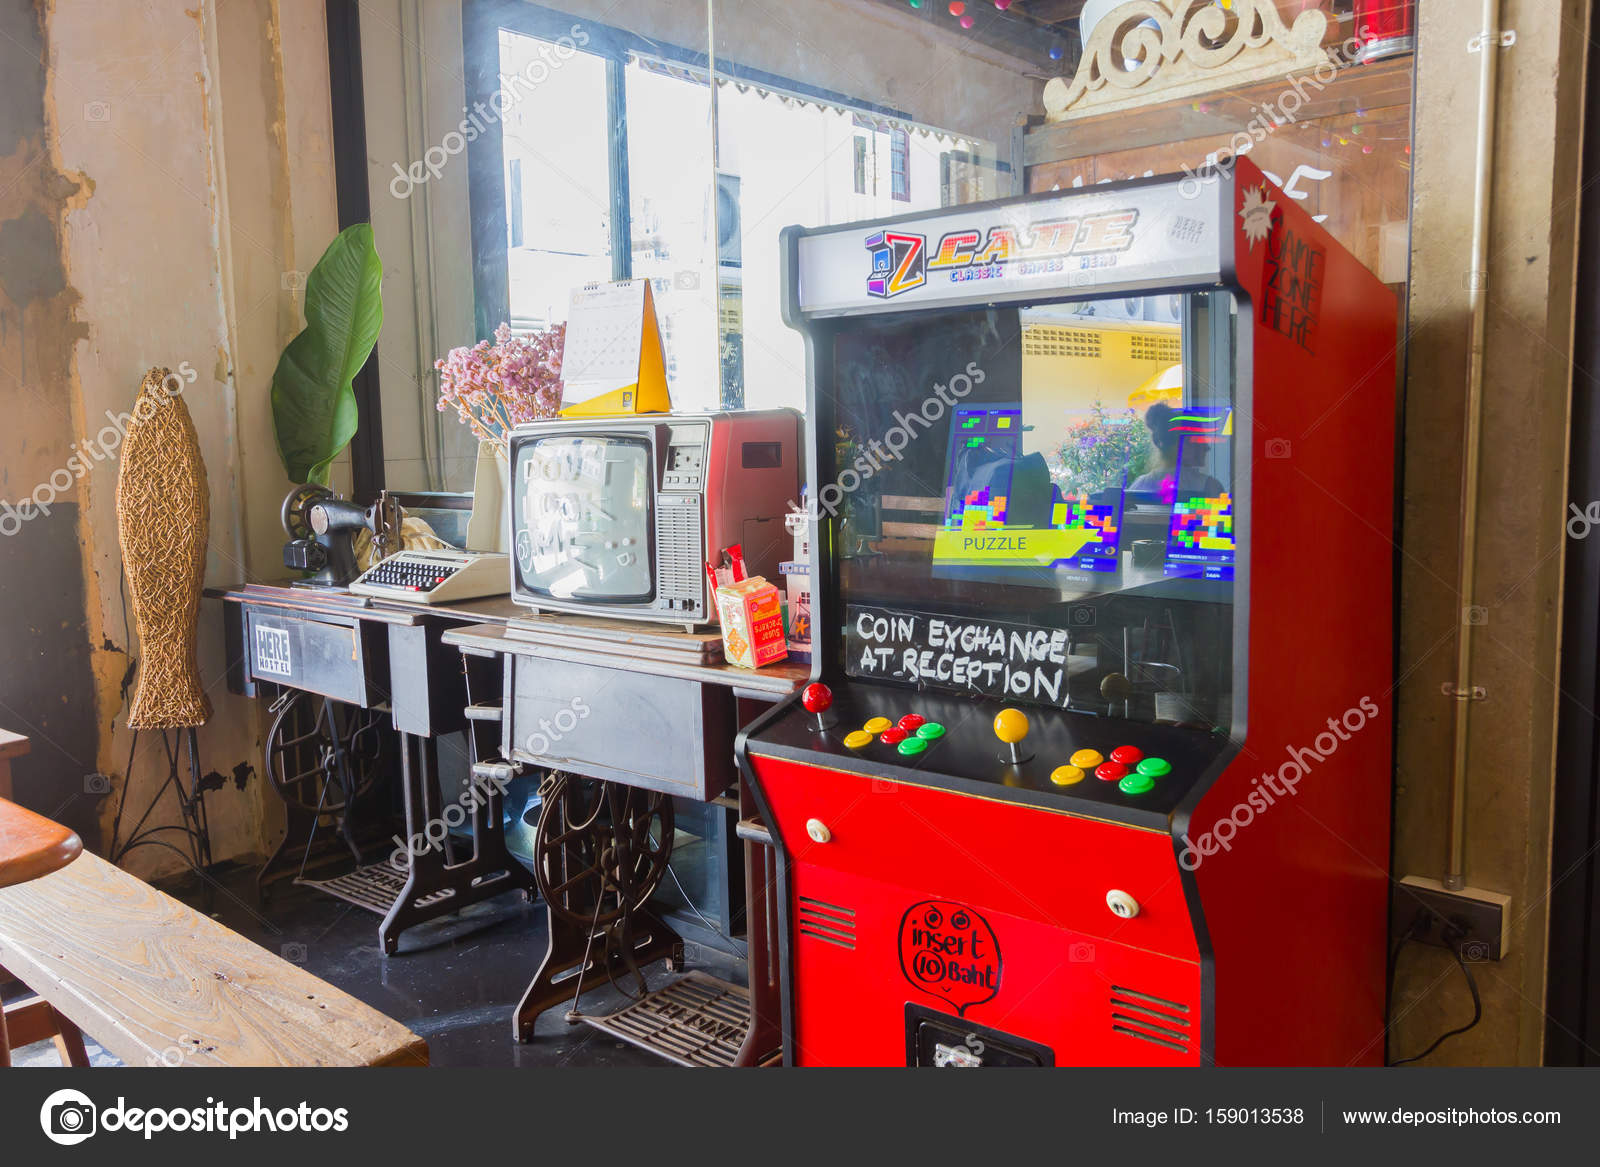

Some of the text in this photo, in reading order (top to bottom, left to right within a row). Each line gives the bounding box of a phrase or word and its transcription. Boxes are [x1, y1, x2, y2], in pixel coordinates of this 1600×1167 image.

[1267, 216, 1325, 283] GAME
[950, 266, 1003, 282] CLASSIC
[1018, 258, 1063, 275] GAMES
[1266, 259, 1320, 320] ZONE
[1261, 288, 1318, 356] HERE
[963, 536, 1028, 551] PUZZLE
[257, 630, 289, 661] HERE
[856, 613, 1069, 665] COIN EXCHANGE
[259, 658, 289, 673] HOSTEL
[860, 645, 894, 673] AT
[912, 919, 985, 959] insert
[948, 961, 996, 990] Baht
